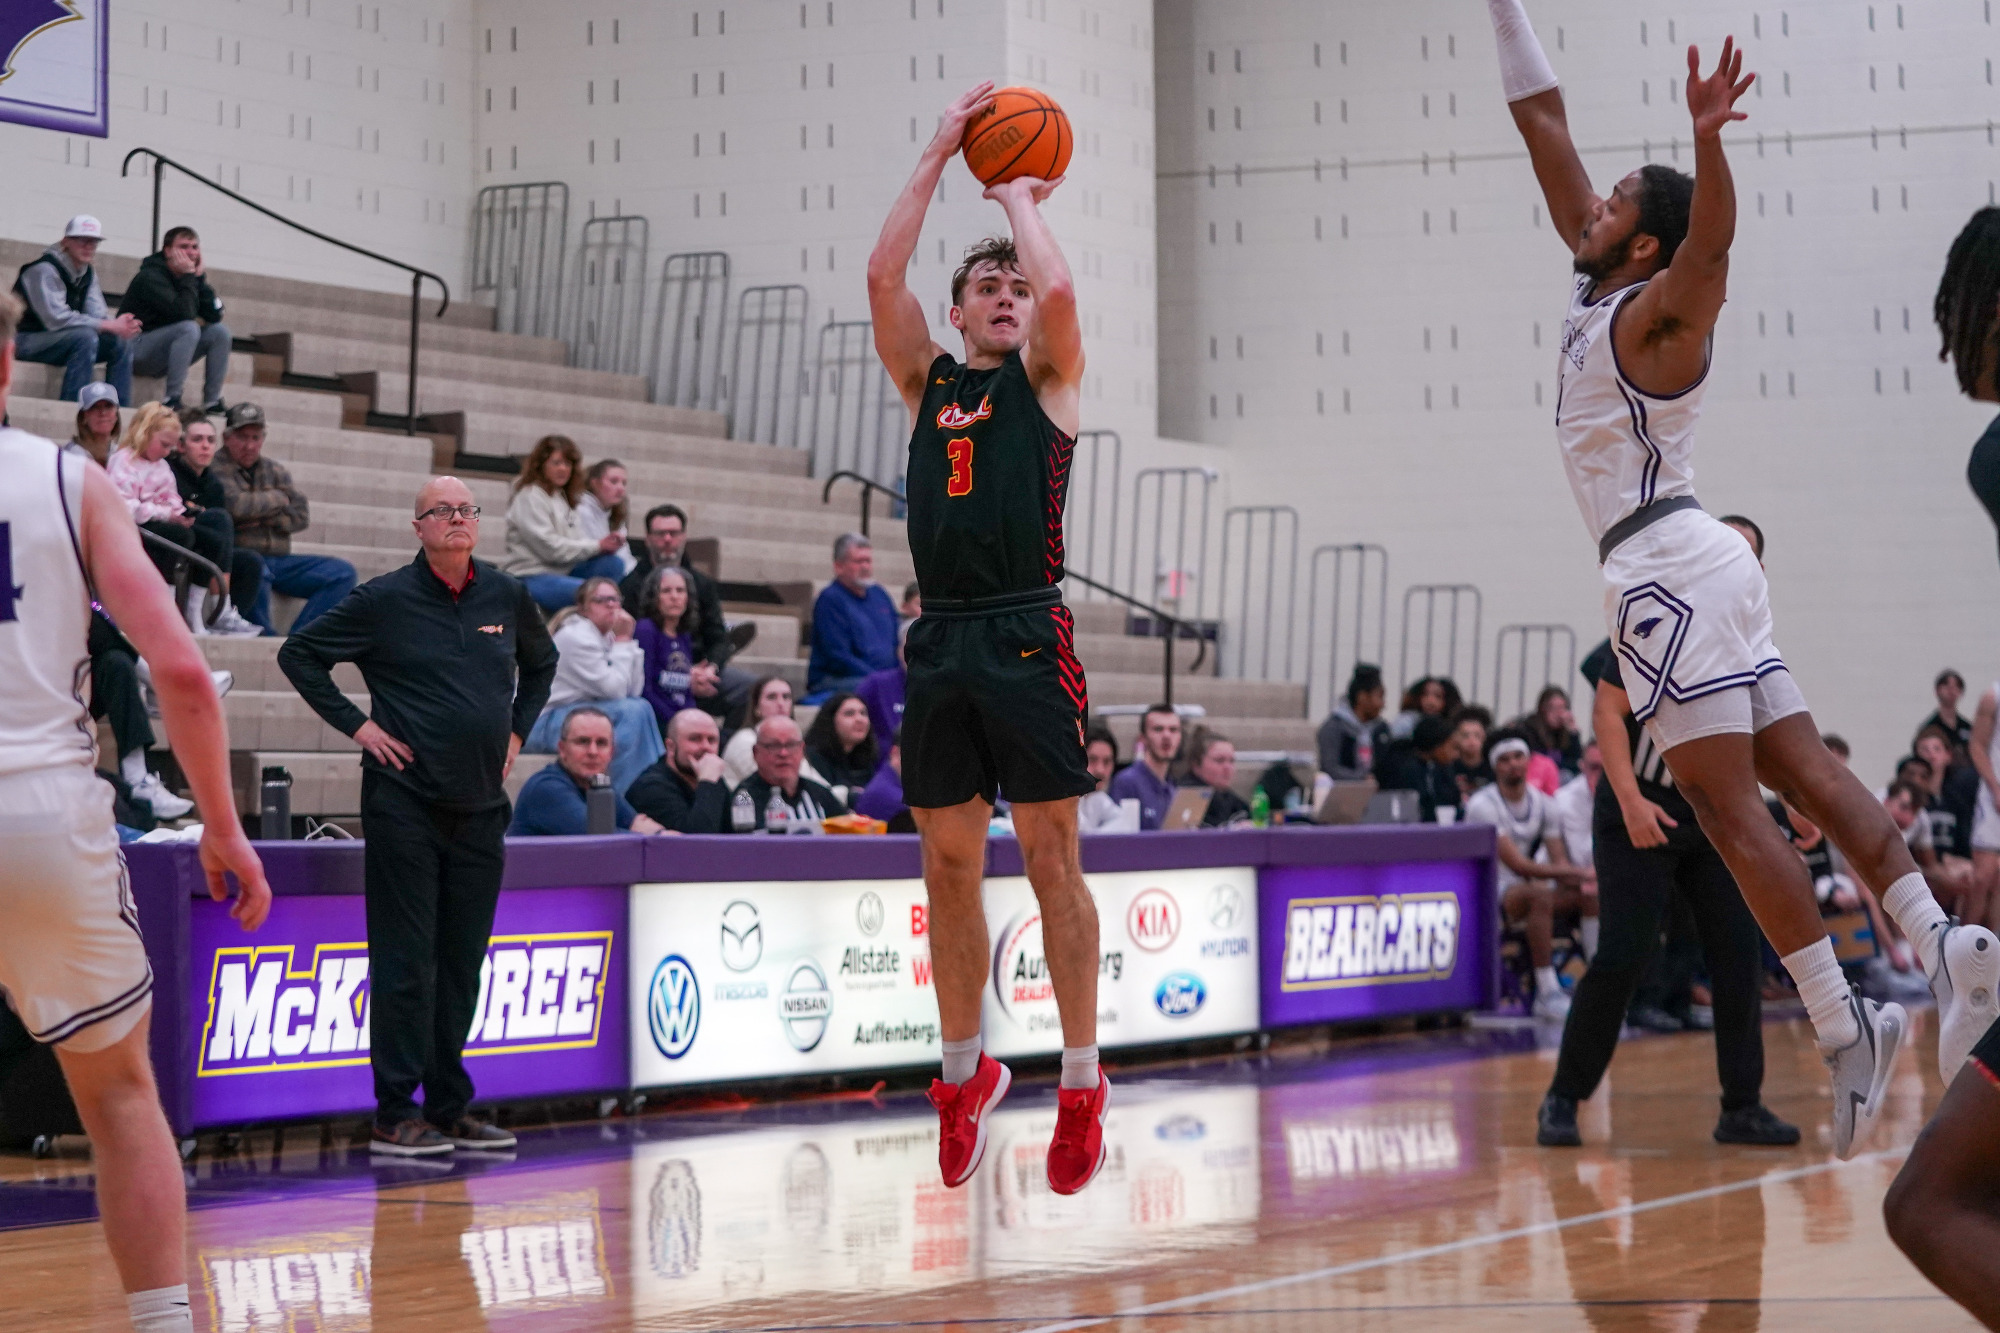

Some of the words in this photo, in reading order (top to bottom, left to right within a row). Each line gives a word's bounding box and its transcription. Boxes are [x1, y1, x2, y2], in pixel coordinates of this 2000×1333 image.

[948, 437, 973, 497] 3
[1136, 903, 1172, 939] KIA
[1286, 901, 1458, 981] BEARCATS
[839, 945, 900, 975] Allstate
[208, 945, 604, 1062] McKREE
[784, 998, 828, 1013] NISSAN
